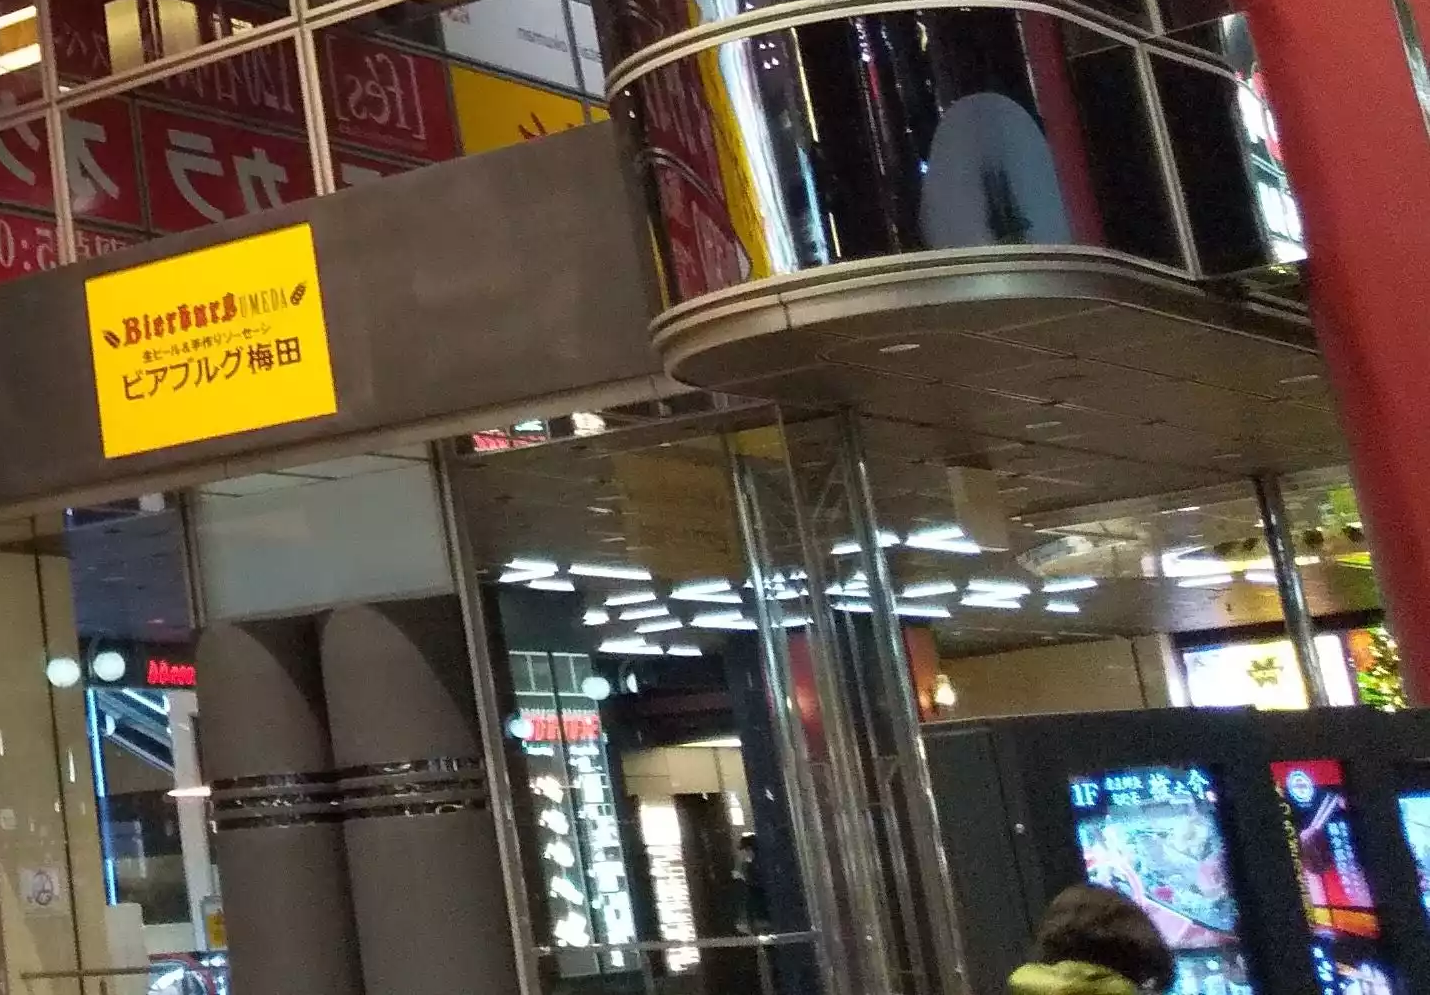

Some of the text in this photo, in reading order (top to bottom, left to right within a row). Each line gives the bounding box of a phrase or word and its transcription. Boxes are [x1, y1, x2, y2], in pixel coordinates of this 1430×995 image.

[238, 287, 289, 319] UMEDA
[121, 336, 302, 401] ビアブルグ梅田
